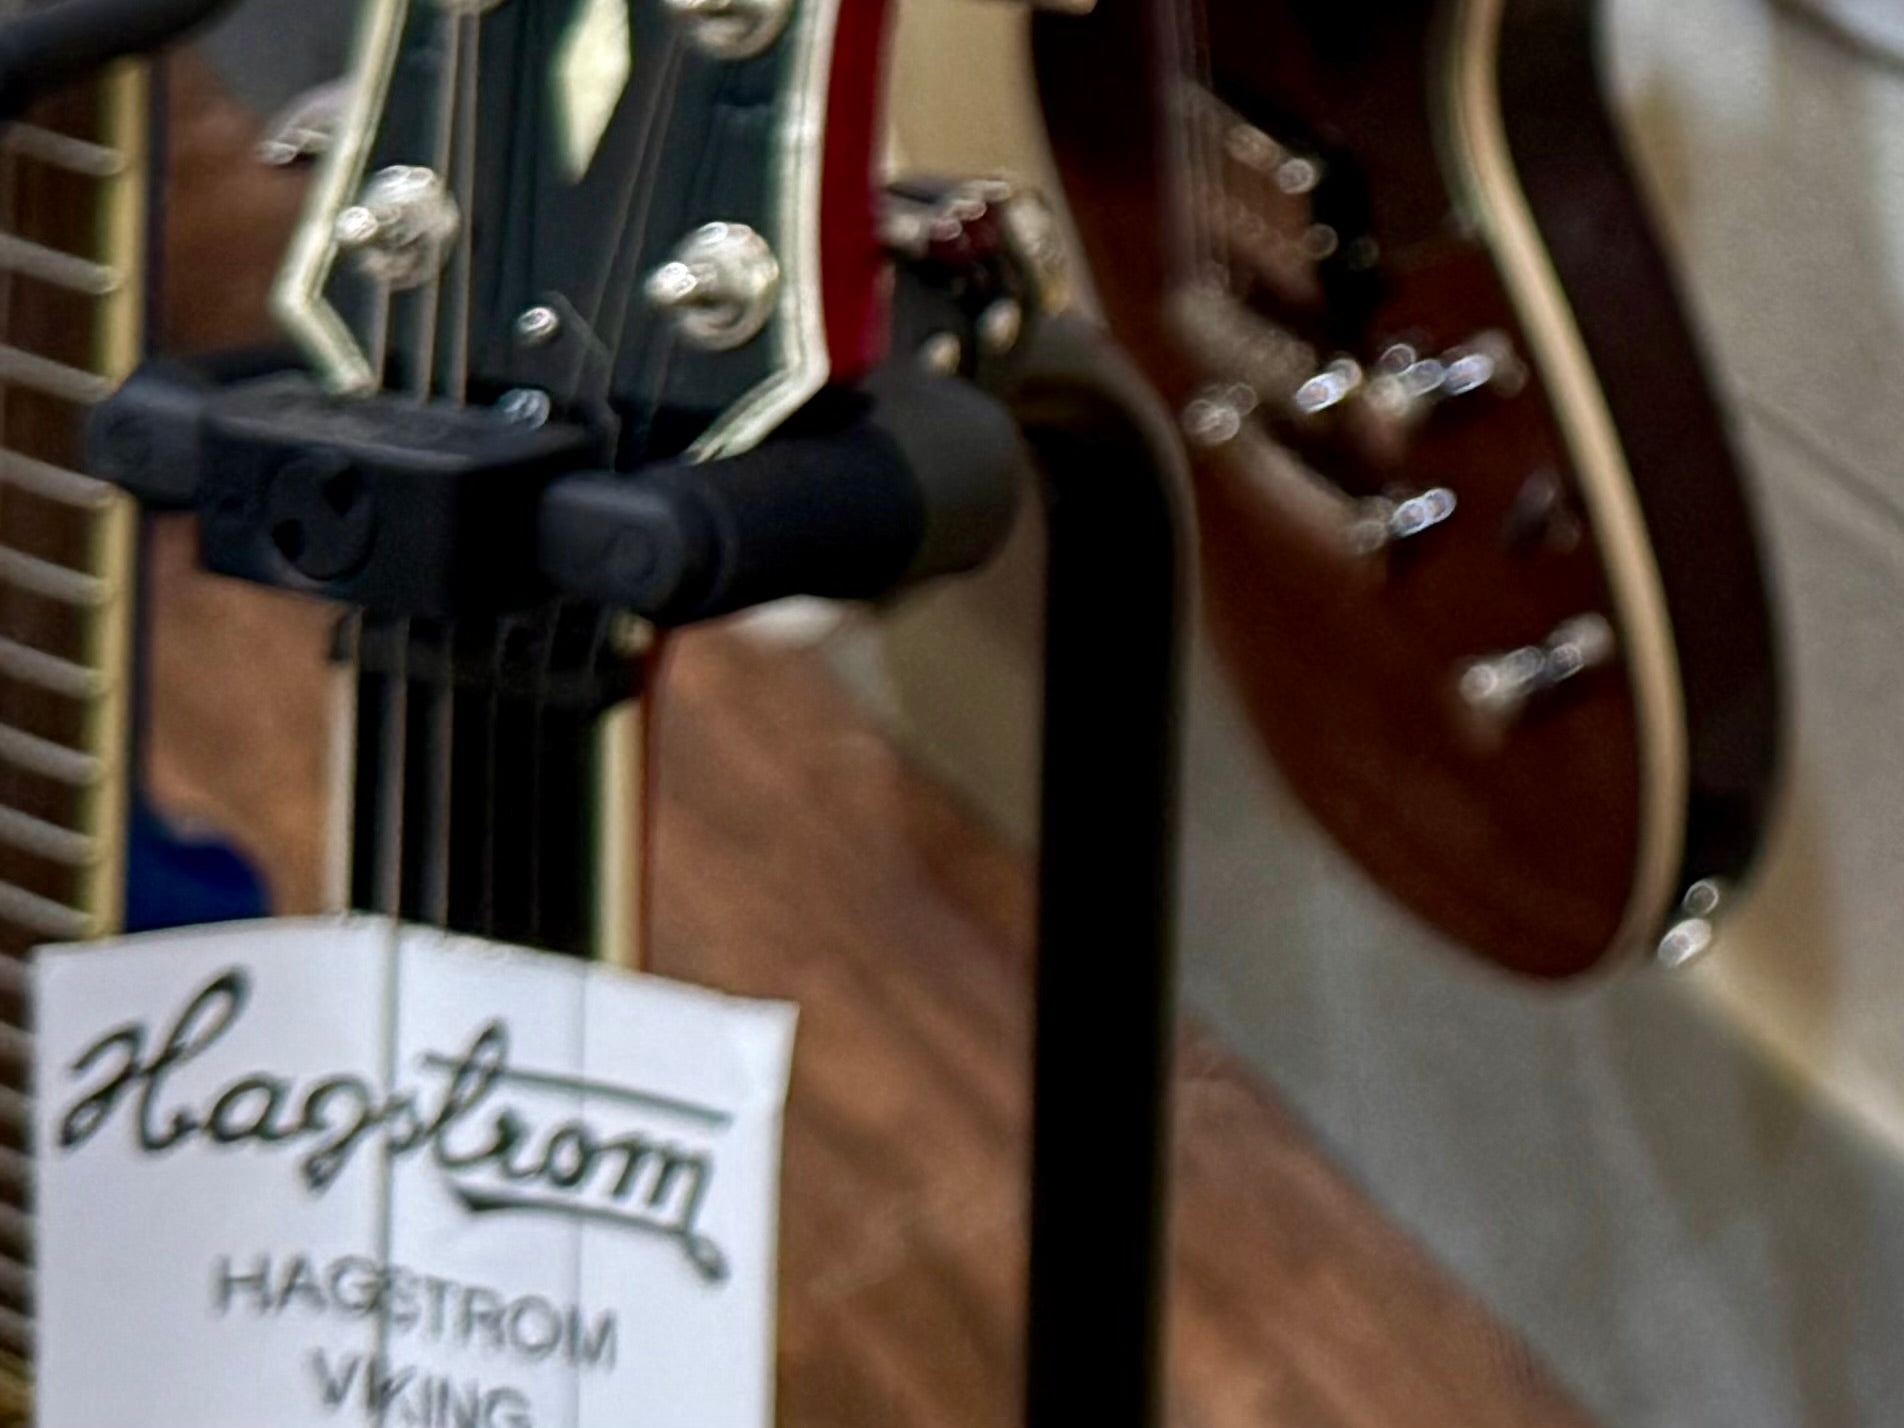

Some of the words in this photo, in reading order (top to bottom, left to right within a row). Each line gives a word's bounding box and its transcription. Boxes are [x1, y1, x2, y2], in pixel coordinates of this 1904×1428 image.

[58, 964, 732, 1286] Hagstrom
[212, 1252, 620, 1374] HAGSTROM
[309, 1346, 533, 1428] VIKING
